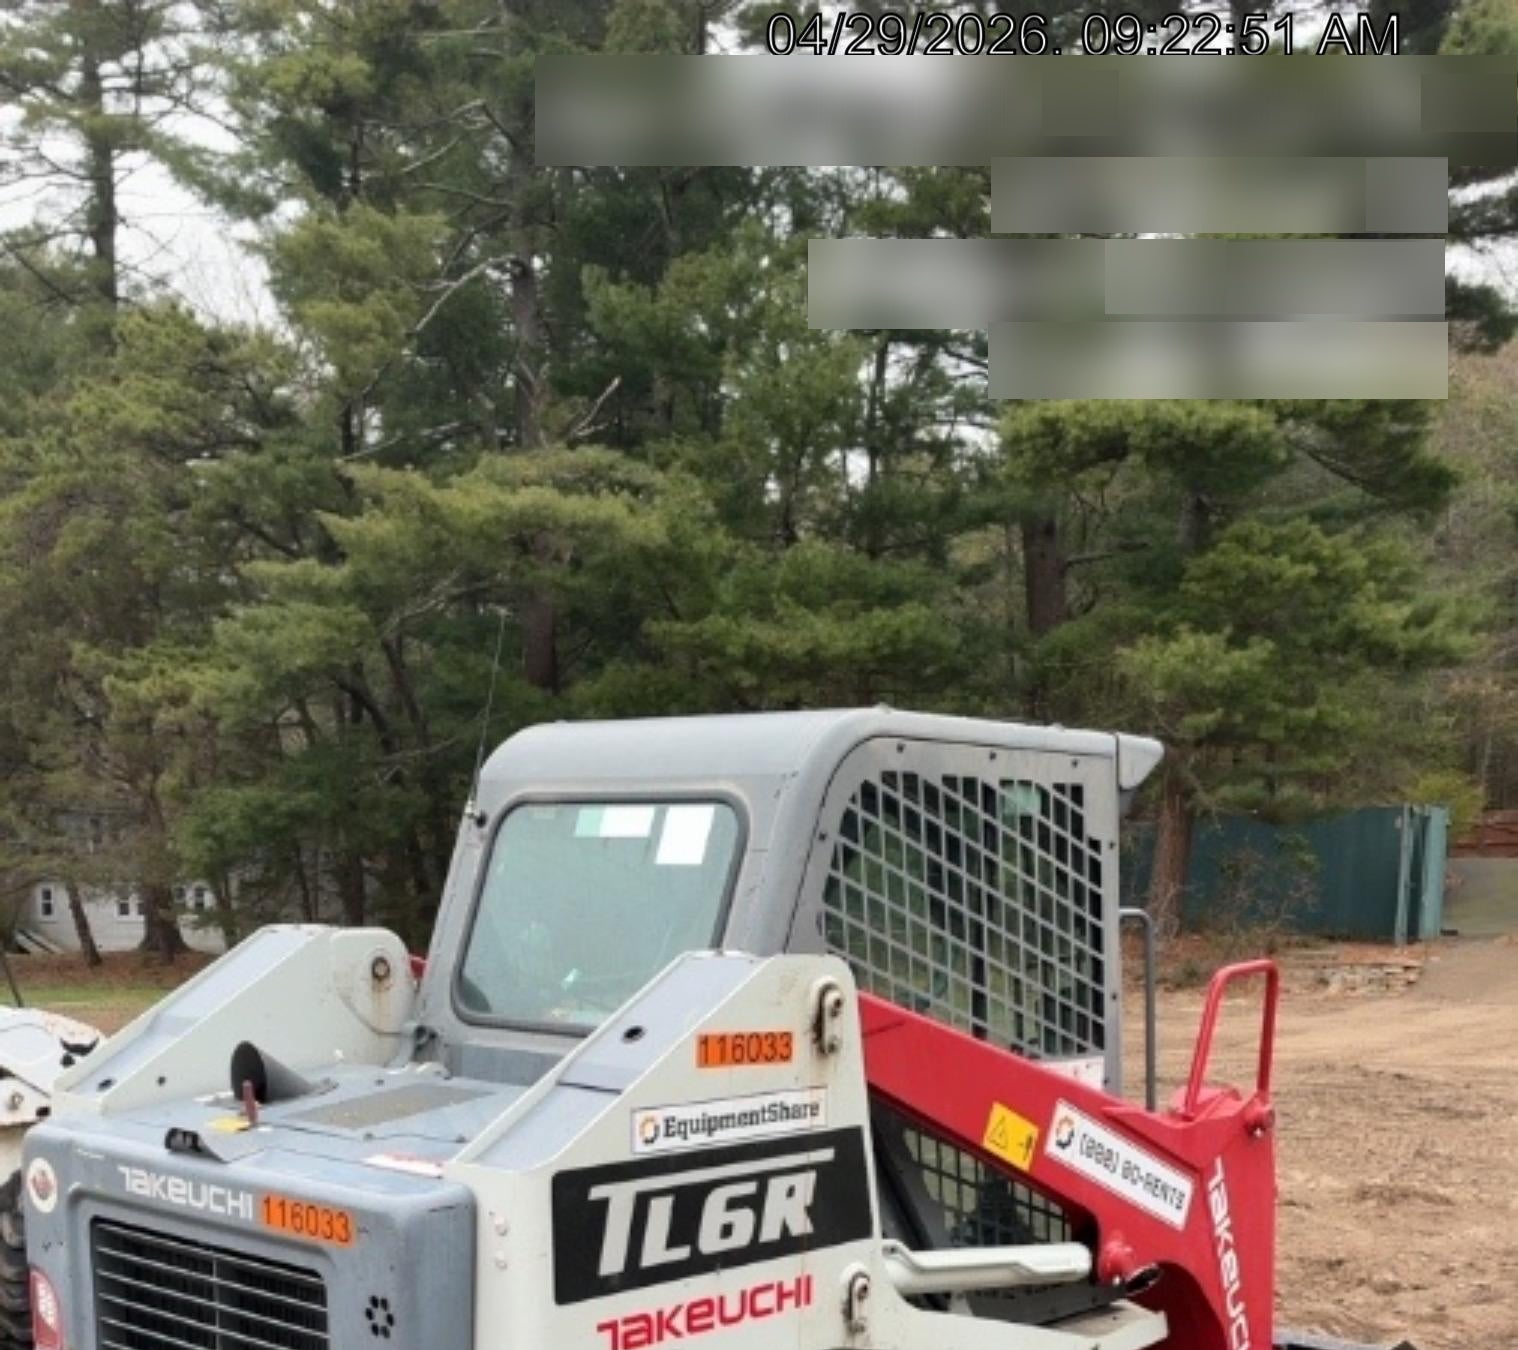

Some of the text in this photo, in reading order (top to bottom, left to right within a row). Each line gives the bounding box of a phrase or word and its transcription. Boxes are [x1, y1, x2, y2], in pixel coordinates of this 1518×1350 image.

[700, 1031, 793, 1065] 116033
[663, 1101, 821, 1140] EquipmentShare
[117, 1164, 254, 1220] TAKEUCHI
[587, 1147, 835, 1278] TL6R
[263, 1194, 352, 1243] 116033
